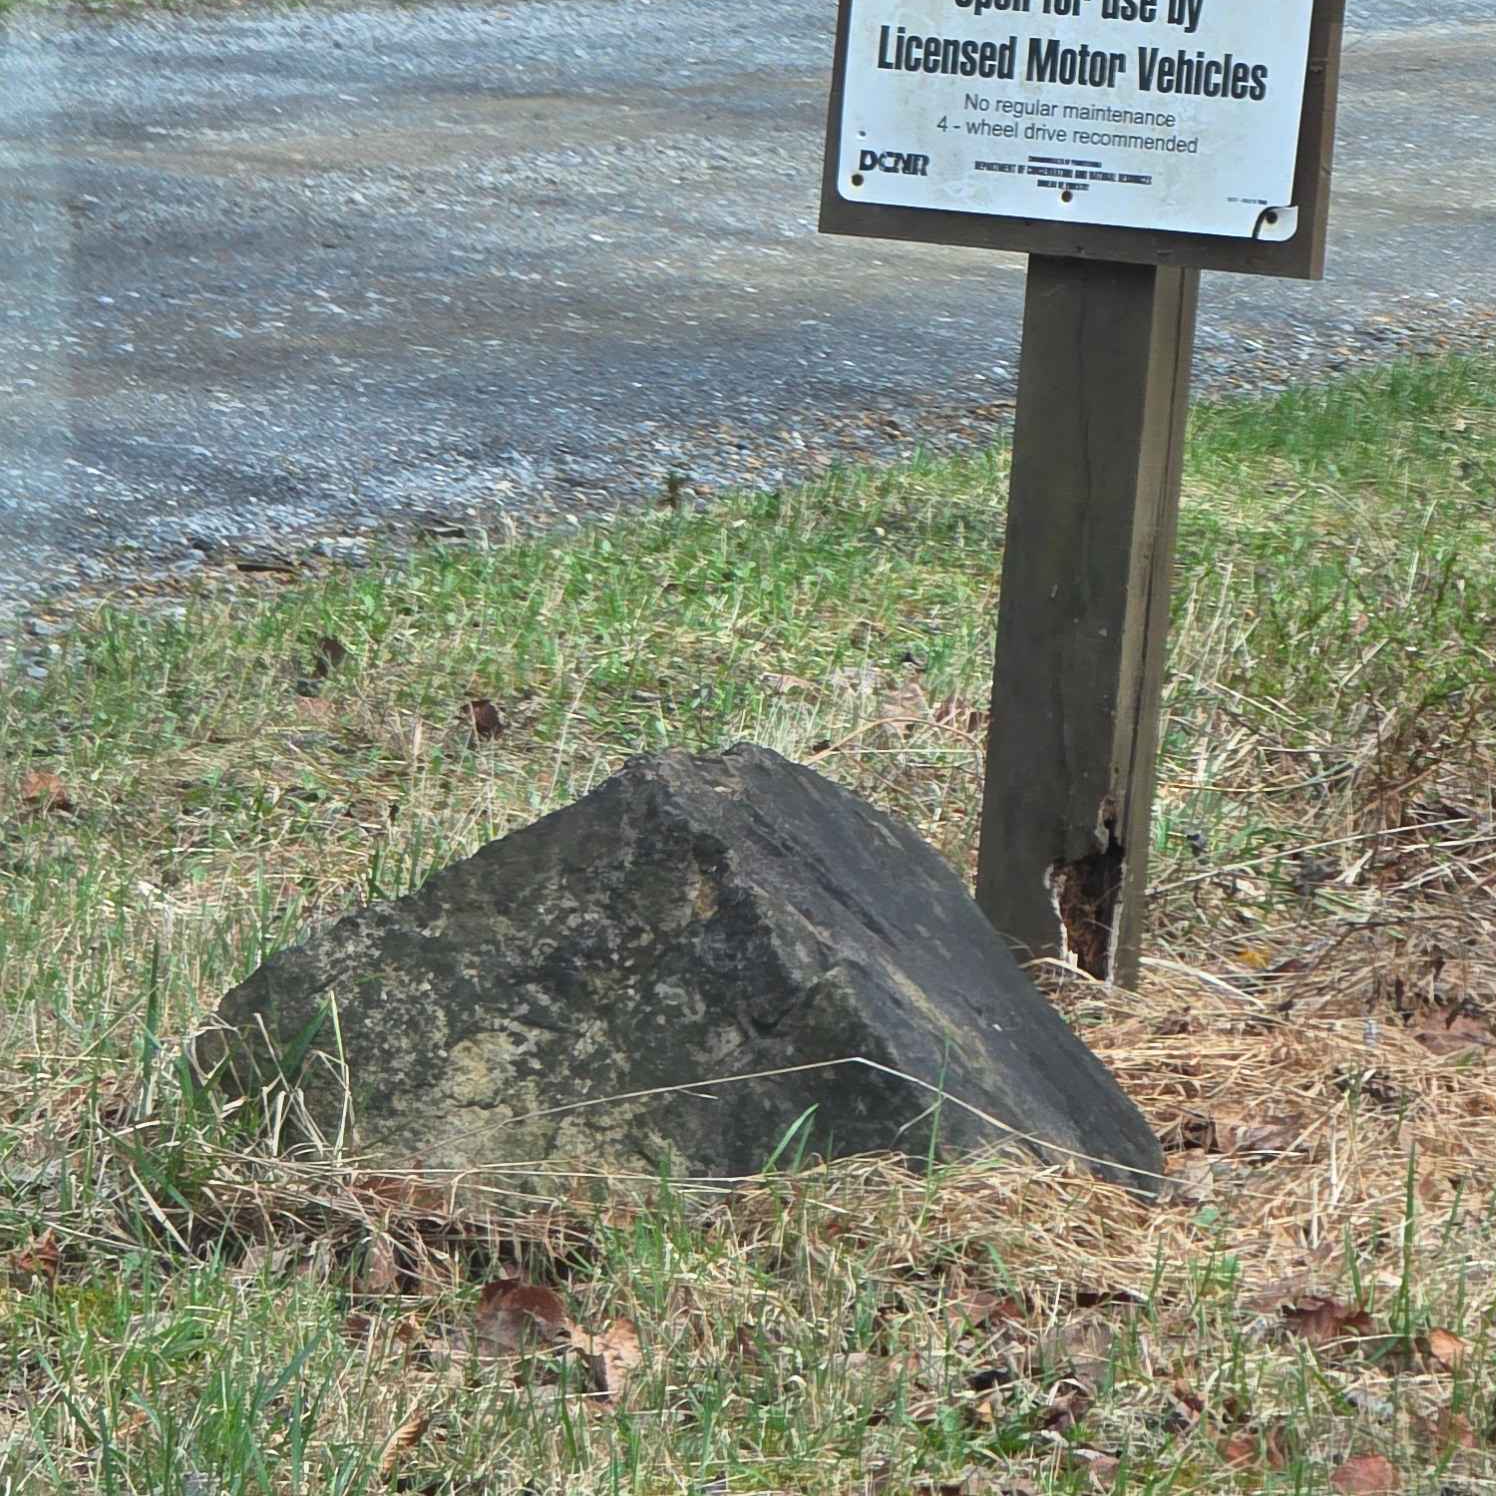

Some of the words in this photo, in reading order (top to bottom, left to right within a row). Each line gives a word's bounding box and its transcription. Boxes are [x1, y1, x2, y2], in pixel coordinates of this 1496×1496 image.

[877, 25, 1017, 80] Licensed
[1025, 38, 1126, 88] Motor
[1137, 46, 1268, 101] Vehicles
[964, 93, 990, 111] No
[995, 99, 1058, 119] regular
[1063, 103, 1176, 128] maintenance
[966, 119, 1018, 139] wheel
[1024, 123, 1067, 142] drive
[1072, 131, 1199, 154] recommended
